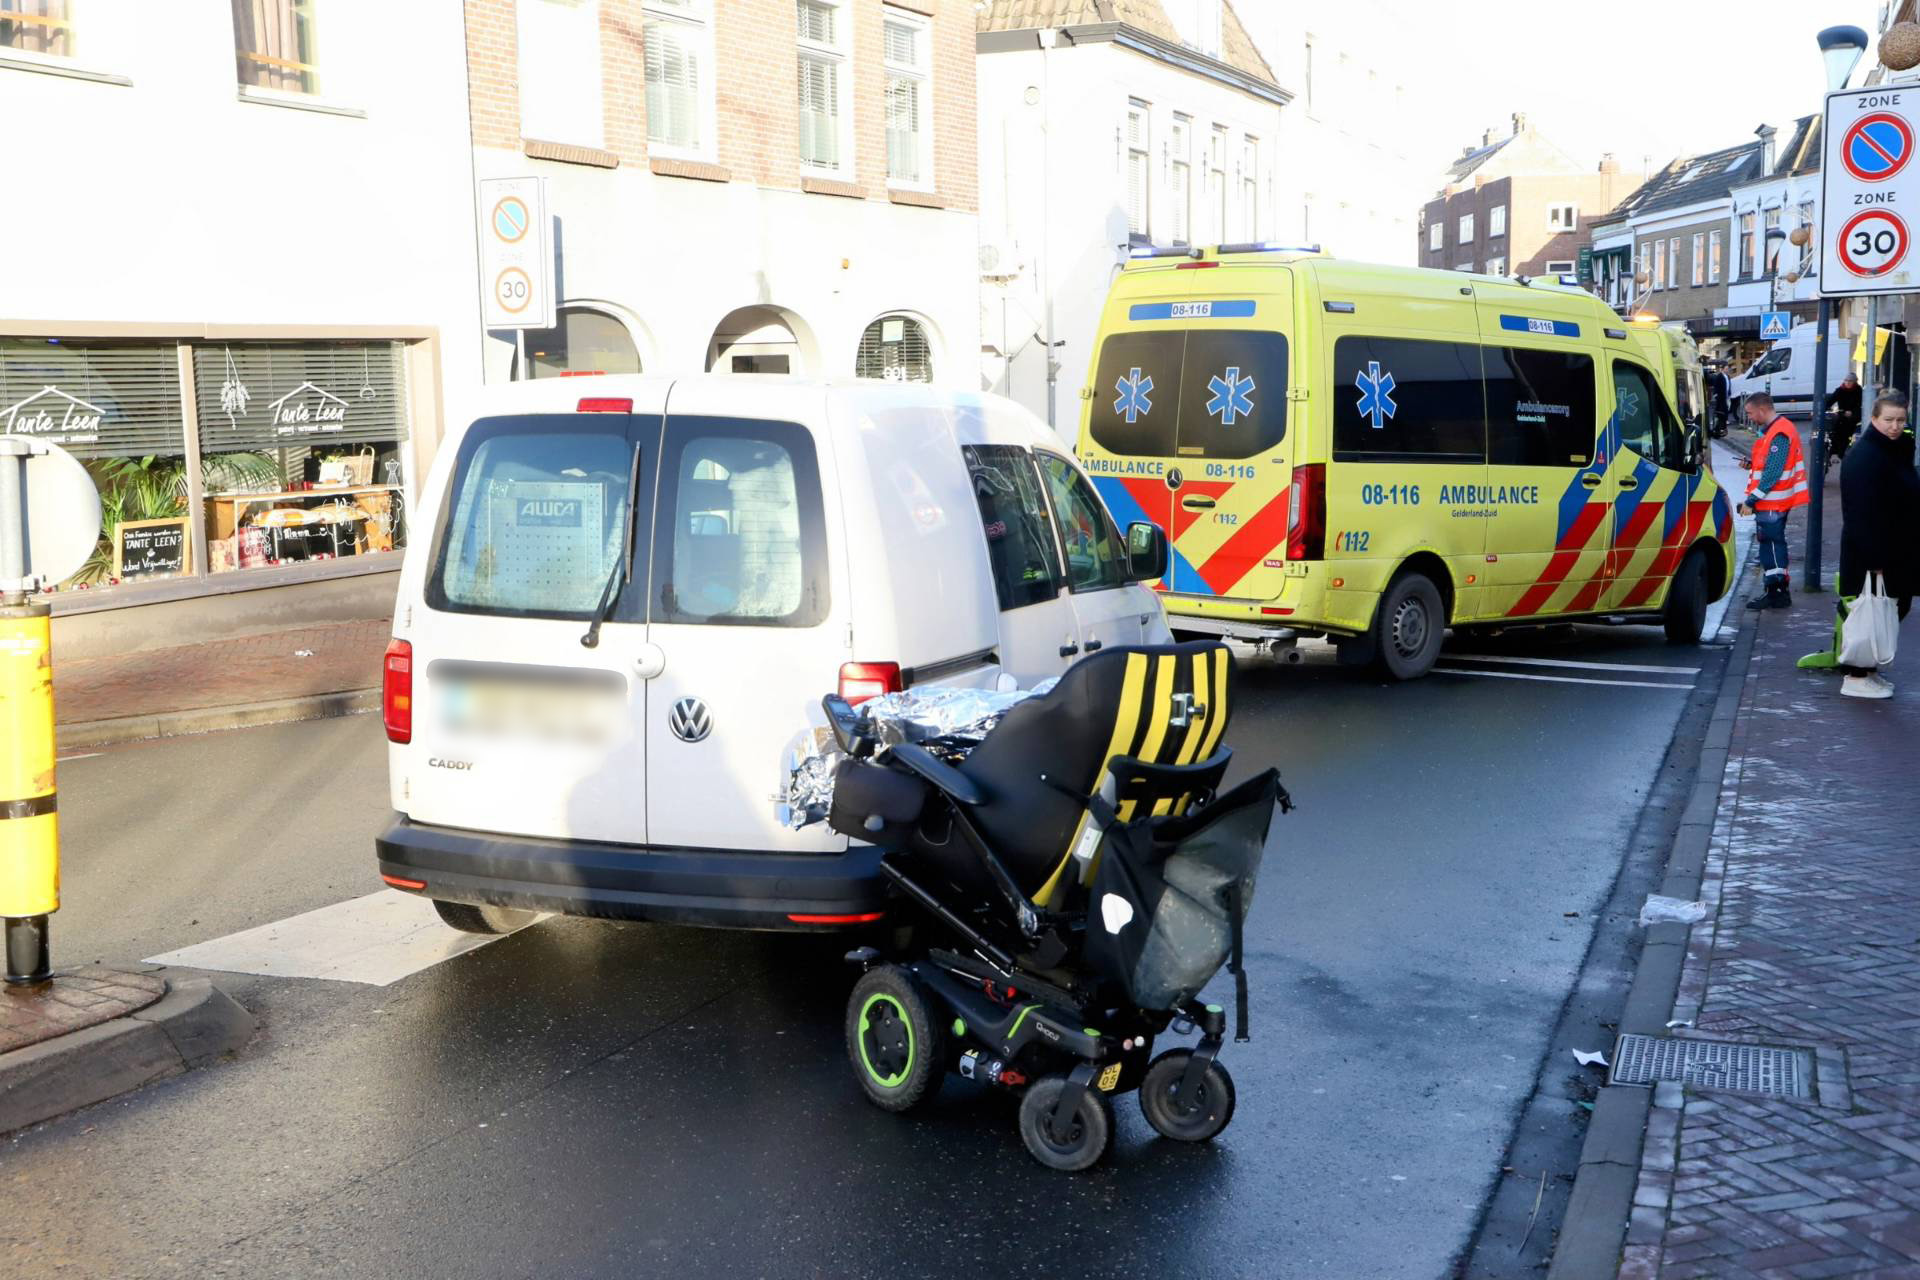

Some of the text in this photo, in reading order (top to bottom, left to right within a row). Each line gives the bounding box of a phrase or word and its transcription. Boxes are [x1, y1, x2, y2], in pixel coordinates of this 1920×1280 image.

[1858, 94, 1901, 109] ZONE
[1854, 191, 1896, 205] ZONE
[1852, 230, 1895, 256] 30
[502, 281, 525, 298] 30
[1172, 304, 1209, 315] 08-116
[1528, 321, 1553, 332] 08-116
[5, 402, 100, 434] Tante Leen
[274, 397, 345, 425] Tante Leen
[1082, 458, 1256, 479] AMBULANCE 08-116
[1361, 484, 1539, 505] 08-116 AMBULANCE
[521, 501, 575, 516] ALUCA
[126, 538, 151, 549] TANTE
[428, 757, 473, 771] CADDY
